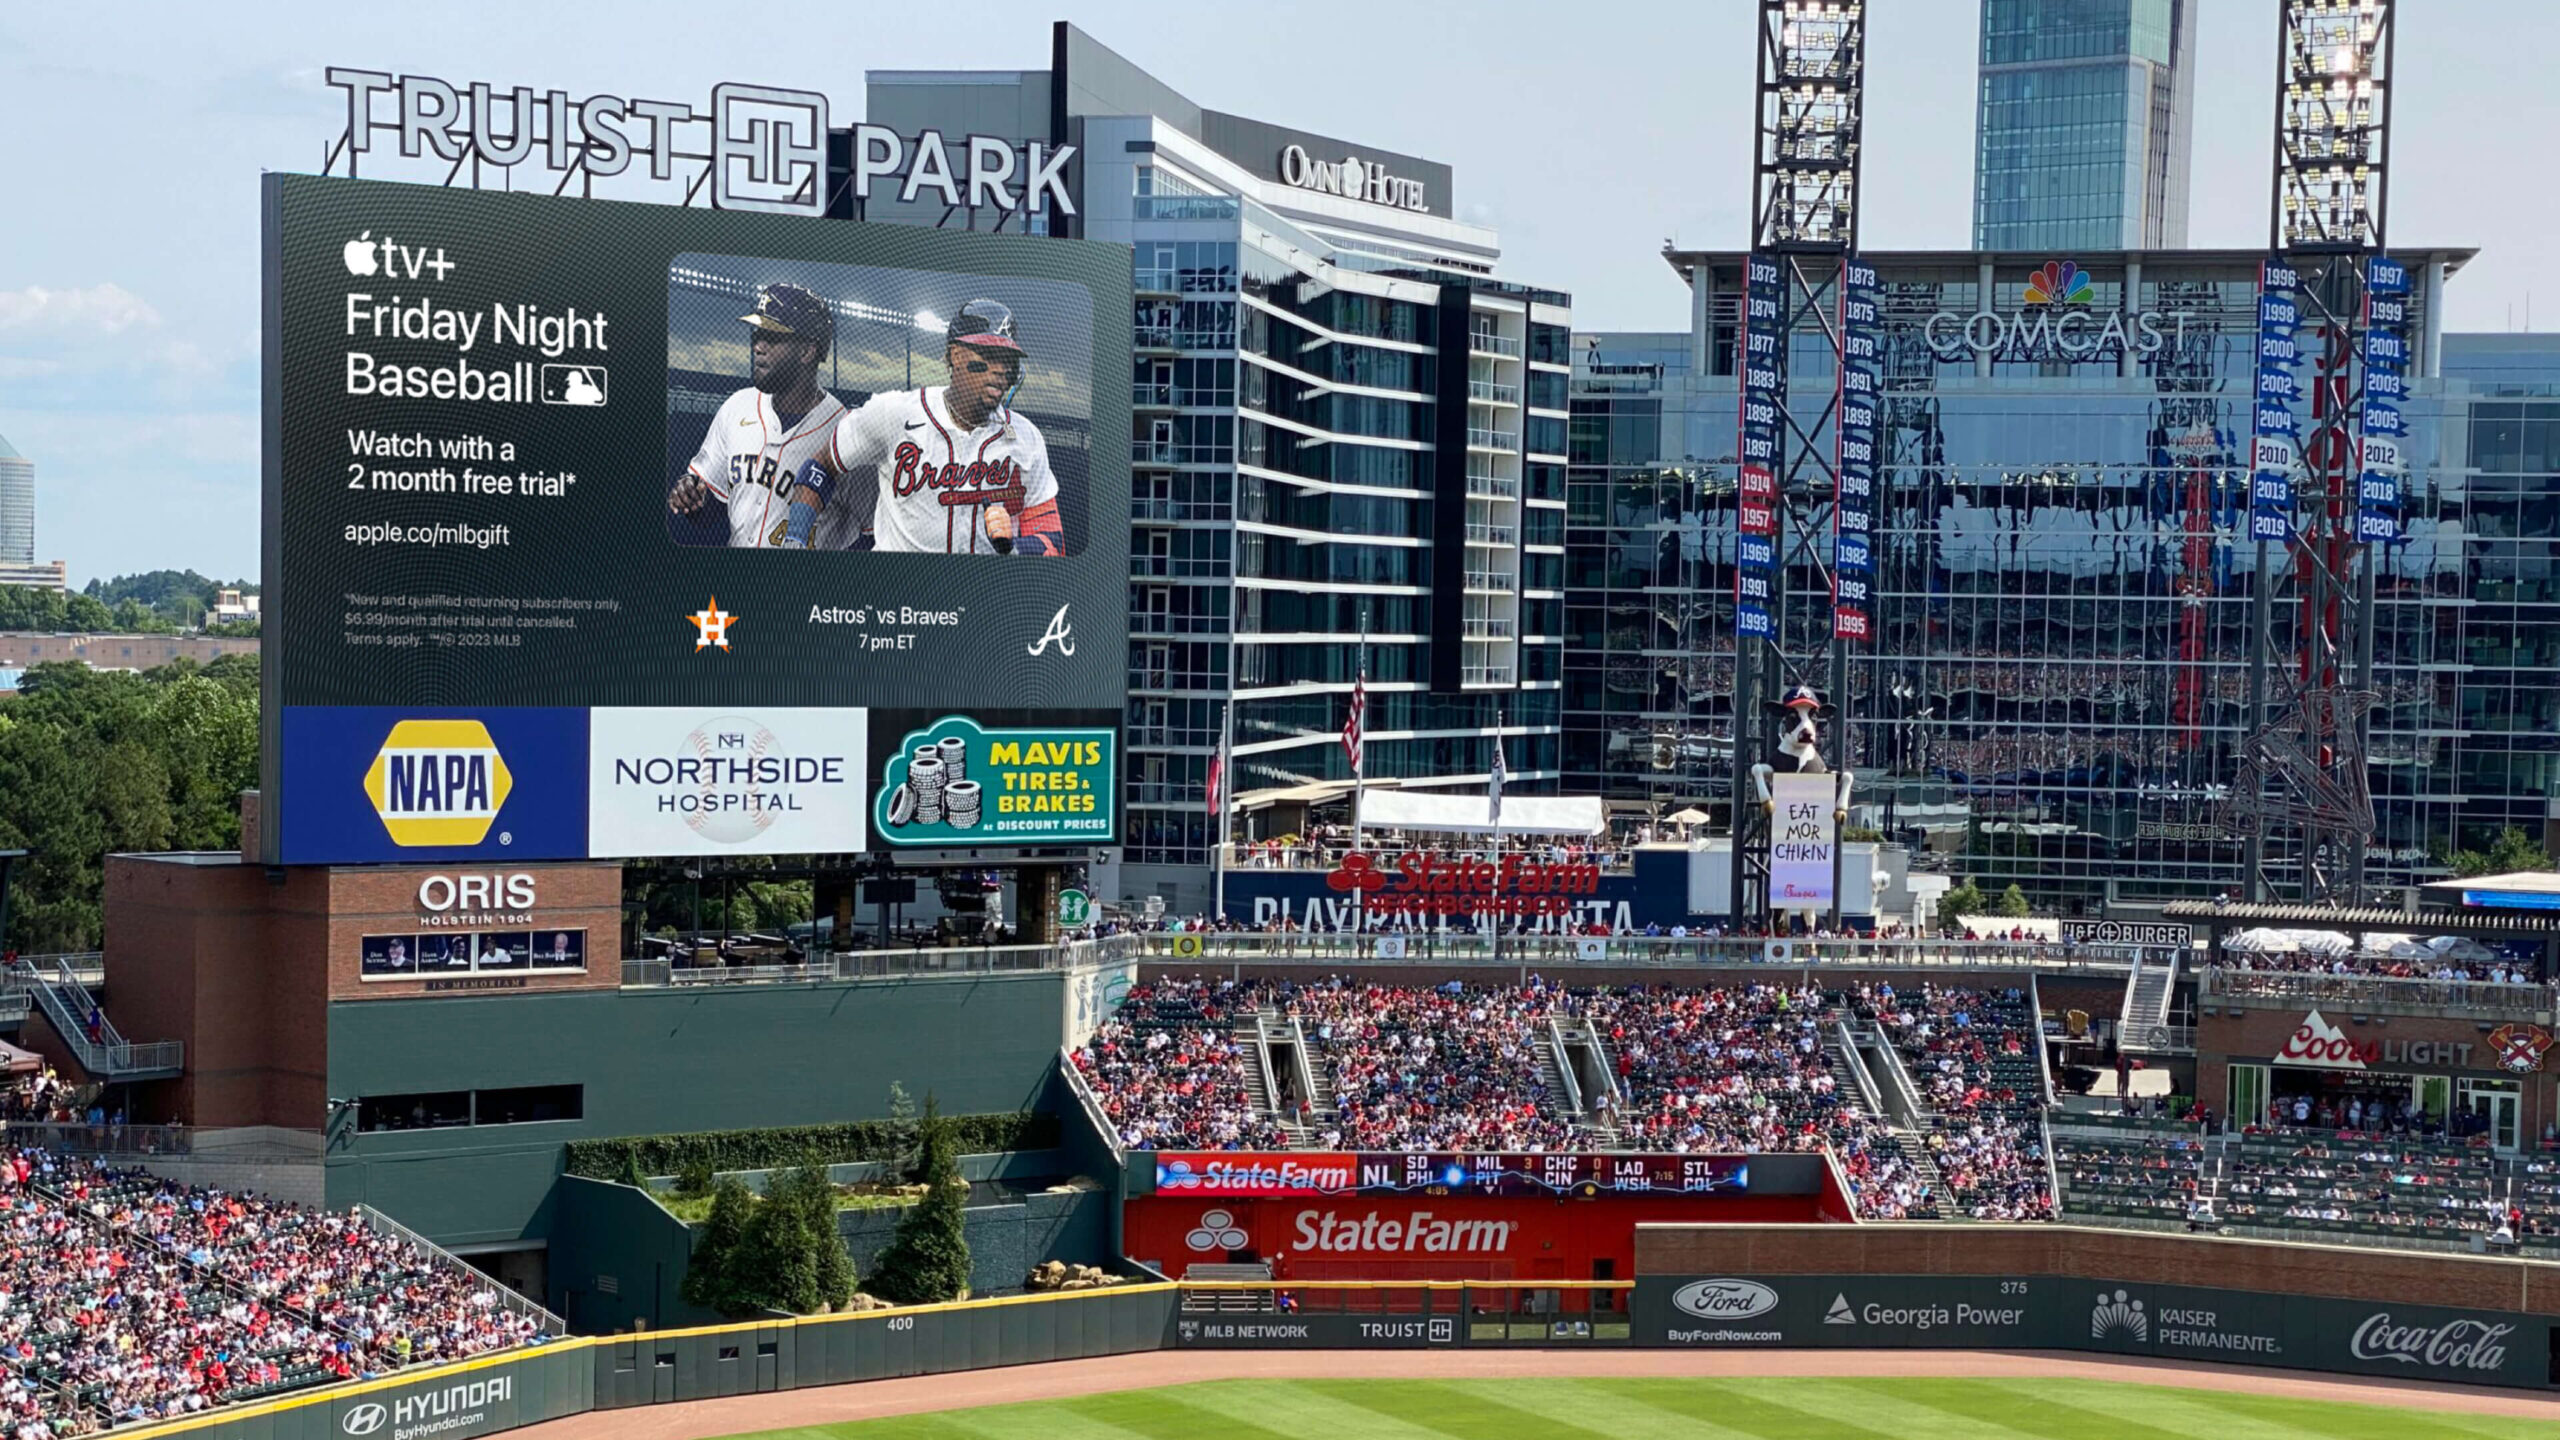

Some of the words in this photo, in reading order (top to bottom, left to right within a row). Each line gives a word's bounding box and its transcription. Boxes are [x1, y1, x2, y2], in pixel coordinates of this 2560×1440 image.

[325, 66, 692, 181] TRUIST
[852, 122, 1077, 215] PARK
[1281, 145, 1342, 196] OMNI
[1363, 161, 1429, 213] HOTEL
[380, 237, 456, 281] tv+
[1750, 263, 1777, 284] 1872
[1848, 266, 1875, 287] 1873
[2265, 267, 2296, 287] 1996
[2372, 265, 2403, 286] 1997
[1749, 299, 1776, 319] 1874
[1847, 301, 1874, 322] 1875
[2263, 303, 2295, 323] 1998
[2371, 301, 2402, 321] 1999
[347, 292, 483, 351] Friday
[494, 302, 608, 357] Night
[1924, 310, 2196, 352] COMCAST
[1748, 333, 1775, 354] 1877
[1846, 336, 1873, 356] 1878
[2262, 338, 2294, 358] 2000
[2369, 337, 2400, 358] 2001
[347, 351, 533, 403] Baseball
[1747, 368, 1775, 388] 1883
[1844, 371, 1871, 391] 1891
[2261, 374, 2292, 394] 2002
[2368, 372, 2400, 393] 2003
[1746, 403, 1774, 423] 1892
[1844, 406, 1872, 426] 1893
[2259, 409, 2291, 429] 2004
[2366, 408, 2399, 430] 2005
[348, 429, 432, 458] Watch
[439, 434, 493, 461] with
[500, 441, 515, 462] a
[1744, 438, 1772, 458] 1897
[1843, 441, 1871, 461] 1898
[2258, 445, 2288, 465] 2010
[2365, 444, 2395, 465] 2012
[348, 463, 365, 490] 2
[372, 467, 456, 493] month
[463, 468, 513, 495] free
[729, 453, 796, 501] STRO
[809, 471, 824, 488] 13
[892, 442, 1011, 498] Braves
[1743, 473, 1770, 493] 1914
[1841, 475, 1870, 496] 1948
[2256, 480, 2286, 501] 2013
[2363, 480, 2394, 501] 2018
[1742, 507, 1770, 528] 1957
[1840, 510, 1869, 531] 1958
[2255, 516, 2285, 536] 2019
[2362, 515, 2393, 537] 2020
[344, 521, 510, 549] apple.co/mlbgift
[1742, 542, 1770, 563] 1969
[1839, 545, 1867, 565] 1982
[1741, 577, 1768, 597] 1991
[1838, 579, 1866, 600] 1992
[381, 594, 406, 606] and
[408, 594, 461, 609] qualified
[464, 596, 519, 611] returning
[521, 597, 592, 610] subscribers
[429, 614, 459, 627] after
[460, 615, 485, 627] trial
[486, 615, 514, 628] until
[877, 607, 896, 626] vs
[1740, 611, 1768, 632] 1993
[1837, 614, 1865, 634] 1995
[344, 632, 383, 645] Terms
[458, 633, 491, 646] 2023
[494, 634, 521, 647] MLB
[858, 633, 869, 650] 7
[870, 636, 894, 653] pm
[897, 634, 916, 651] ET
[989, 741, 1101, 766] MAVIS
[615, 757, 844, 785] NORTHSIDE
[1002, 771, 1078, 790] TIRES
[1081, 779, 1090, 789] &
[390, 754, 489, 812] NAPA
[658, 793, 803, 812] HOSPITAL
[998, 794, 1096, 814] BRAKES
[1788, 802, 1819, 821] EAT
[997, 819, 1060, 831] DISCOUNT
[1063, 818, 1107, 830] PRICES
[1785, 822, 1820, 841] MOR
[419, 873, 537, 911] ORIS
[1363, 893, 1571, 916] NEIGHBORHOOD
[420, 914, 493, 927] HOLSTEIN
[499, 914, 533, 925] 1904
[2122, 925, 2188, 944] BURGER
[2282, 1024, 2382, 1064] Coors
[2383, 1038, 2473, 1067] LIGHT
[1406, 1155, 1428, 1169] SD
[1476, 1155, 1504, 1170] MIL
[1524, 1158, 1532, 1169] 3
[1545, 1156, 1578, 1171] CHC
[1615, 1161, 1643, 1176] LAD
[1684, 1161, 1713, 1176] STL
[1364, 1165, 1396, 1187] NL
[1406, 1171, 1434, 1184] PHI
[1476, 1172, 1499, 1185] PIT
[1545, 1172, 1572, 1185] CIN
[1615, 1177, 1650, 1191] WSH
[1684, 1177, 1714, 1191] COL
[2001, 1281, 2028, 1294] 375
[1694, 1285, 1755, 1312] Ford
[887, 1316, 913, 1331] 400
[1863, 1303, 1949, 1329] Georgia
[1956, 1303, 2024, 1326] Power
[2160, 1308, 2216, 1327] KAISER
[1204, 1325, 1235, 1338] MLB
[1238, 1325, 1308, 1338] NETWORK
[1360, 1322, 1425, 1338] TRUIST
[1668, 1329, 1782, 1342] BuyFordNow.com
[394, 1376, 511, 1425] HYUNDAI
[394, 1412, 484, 1440] BuyHyundai.com
